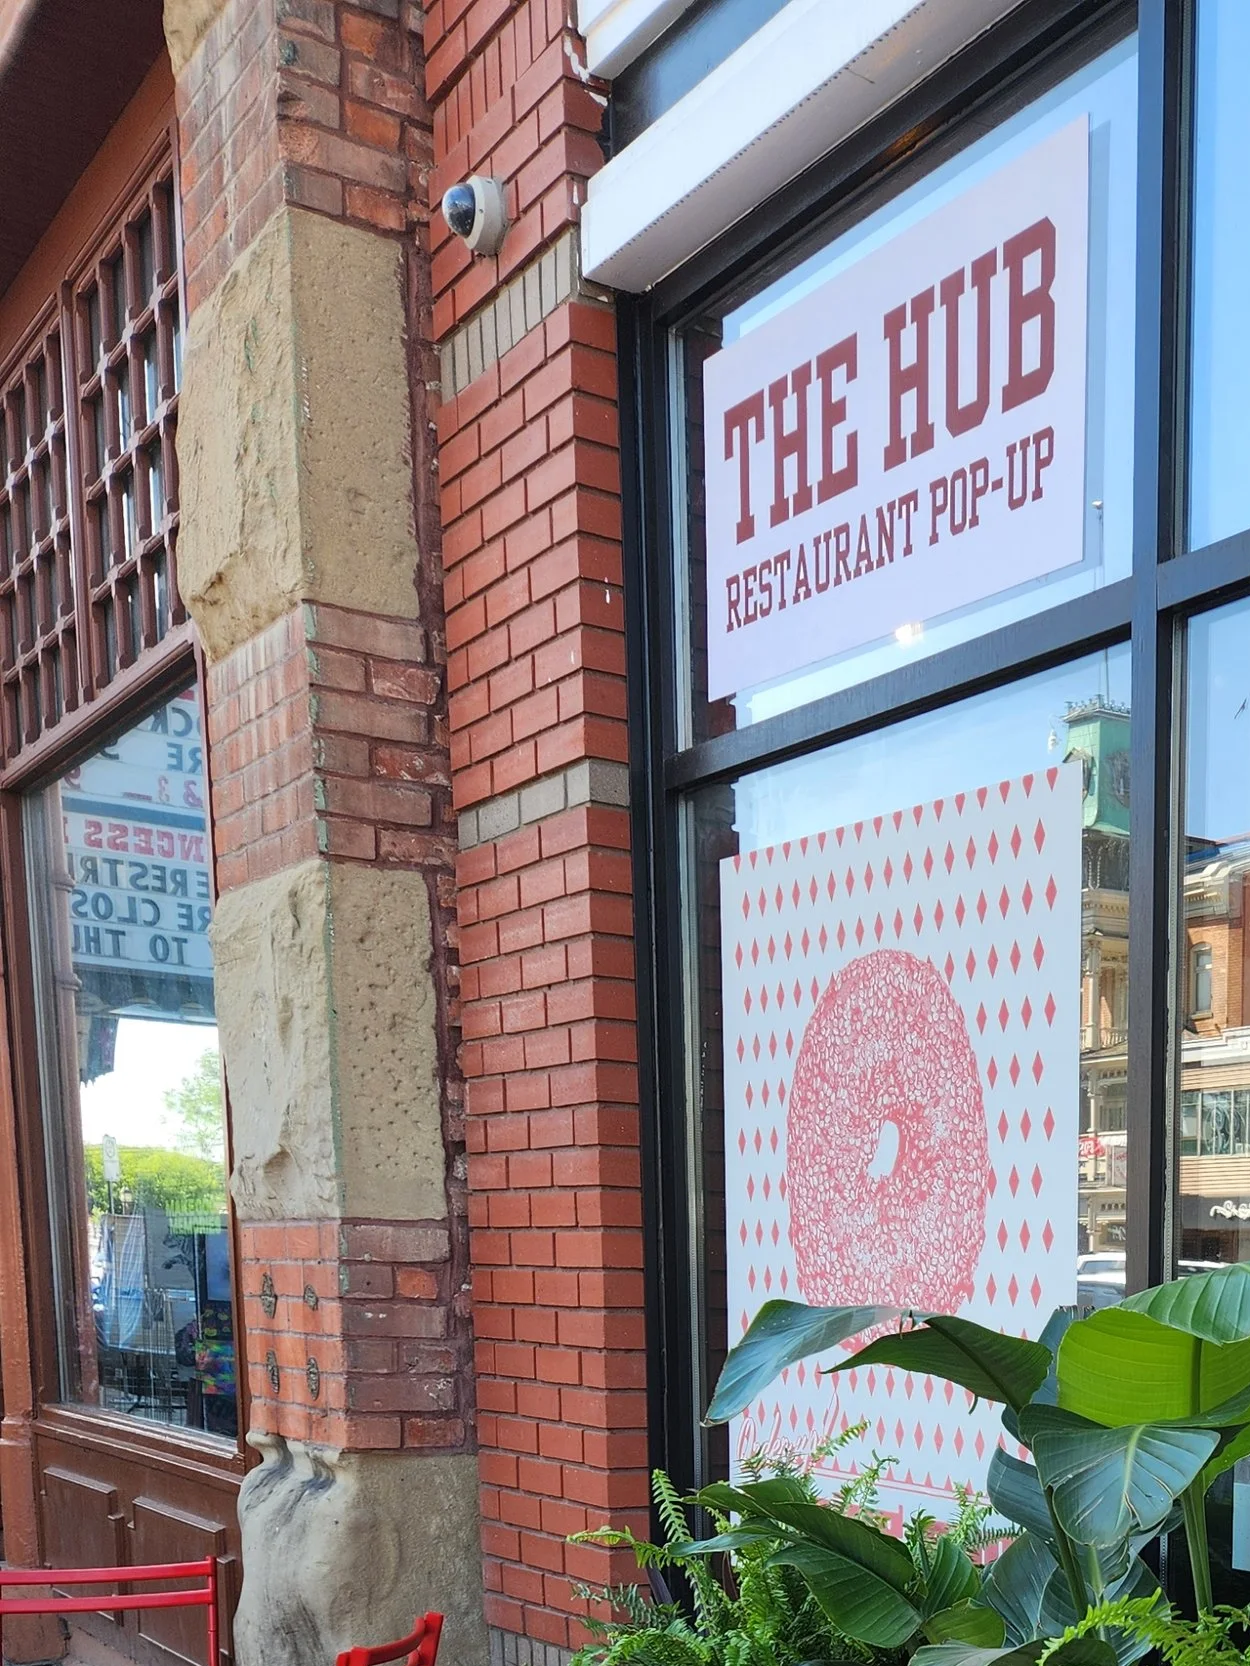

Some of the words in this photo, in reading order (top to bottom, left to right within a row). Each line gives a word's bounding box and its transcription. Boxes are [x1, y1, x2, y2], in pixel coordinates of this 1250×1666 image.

[724, 332, 858, 545] THE
[883, 216, 1056, 472] HUB
[726, 490, 919, 633] RESTAURANT
[928, 426, 1054, 546] POP-UP
